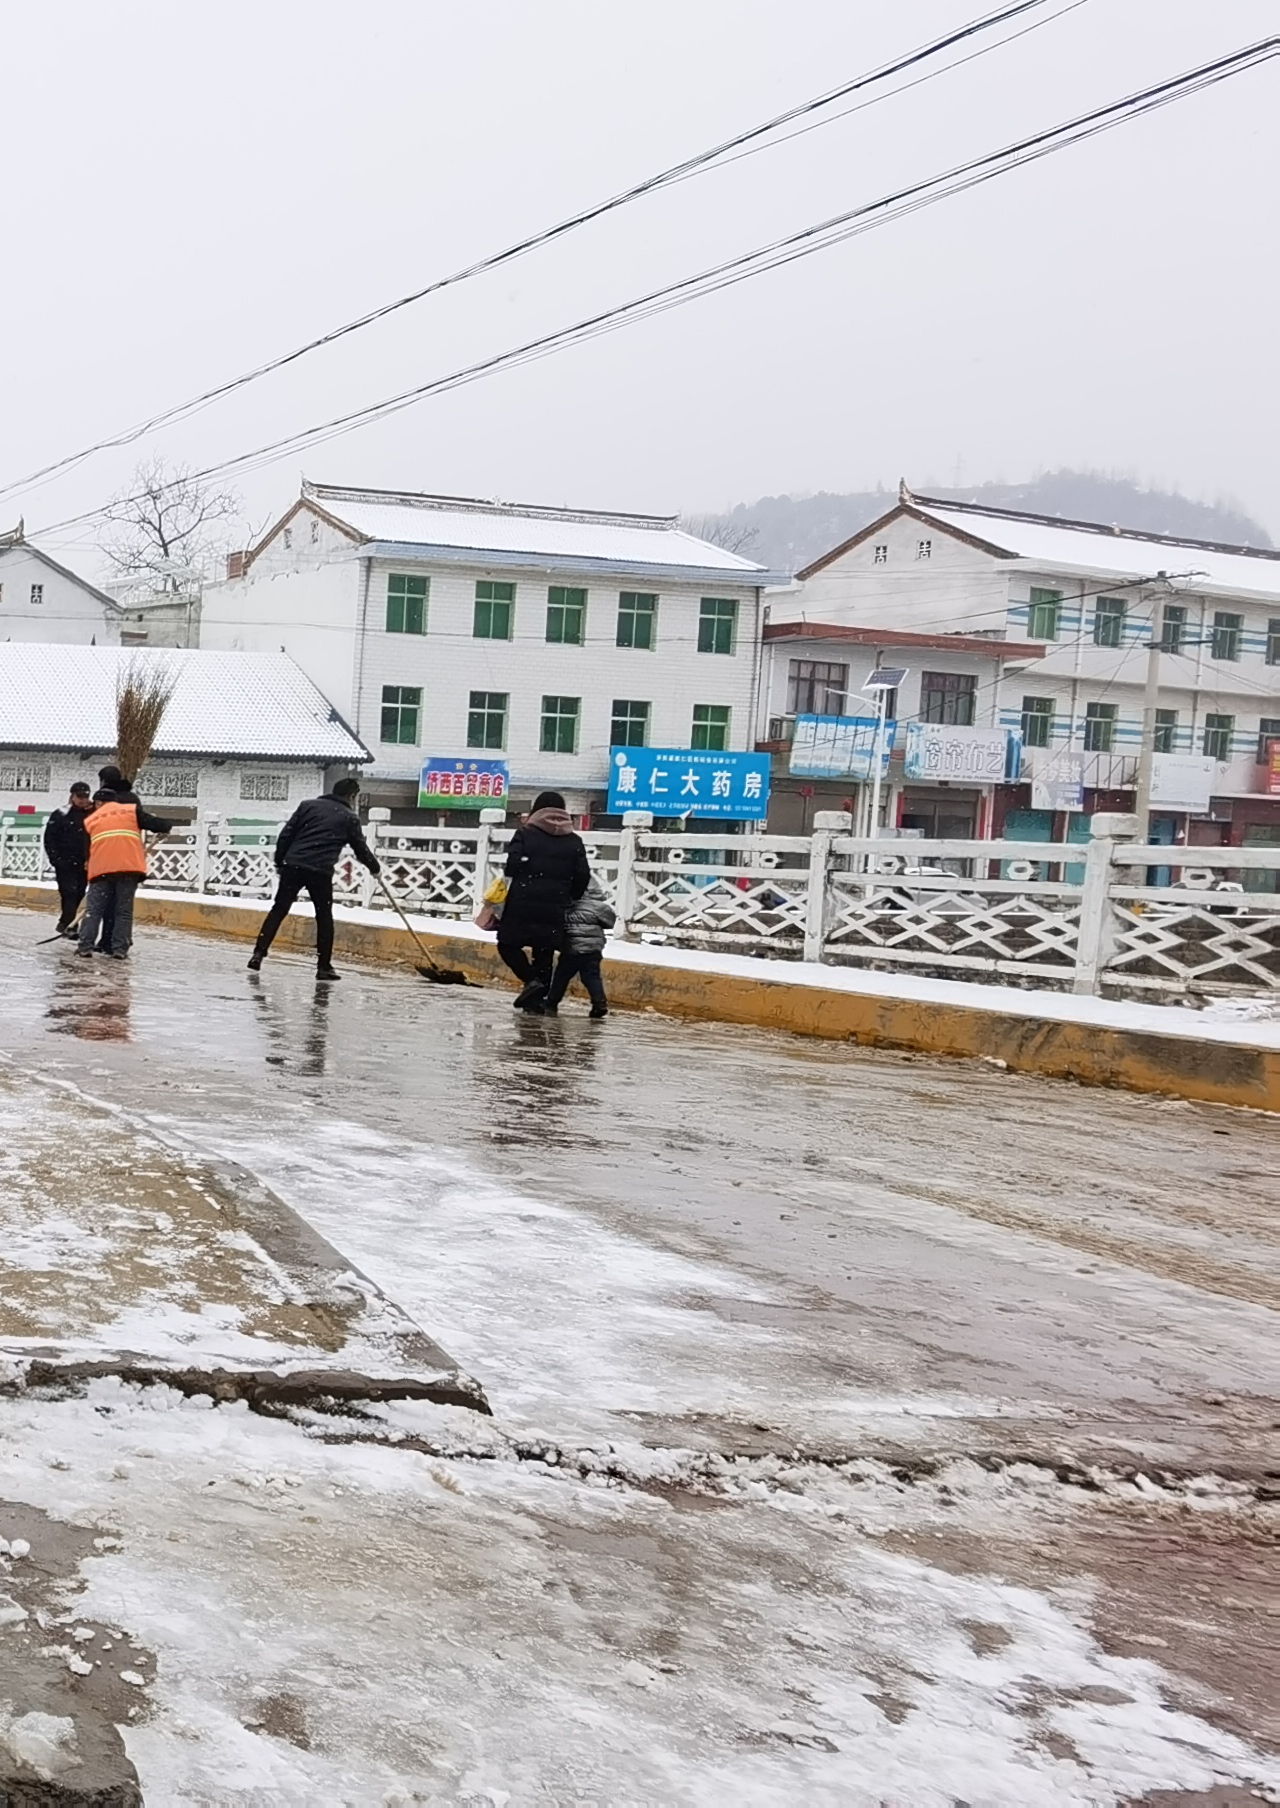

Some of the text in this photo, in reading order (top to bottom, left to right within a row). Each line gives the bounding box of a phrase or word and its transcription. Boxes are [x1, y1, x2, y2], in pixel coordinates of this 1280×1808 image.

[924, 738, 1006, 774] 窗帘布艺
[616, 766, 762, 799] 康仁大药房
